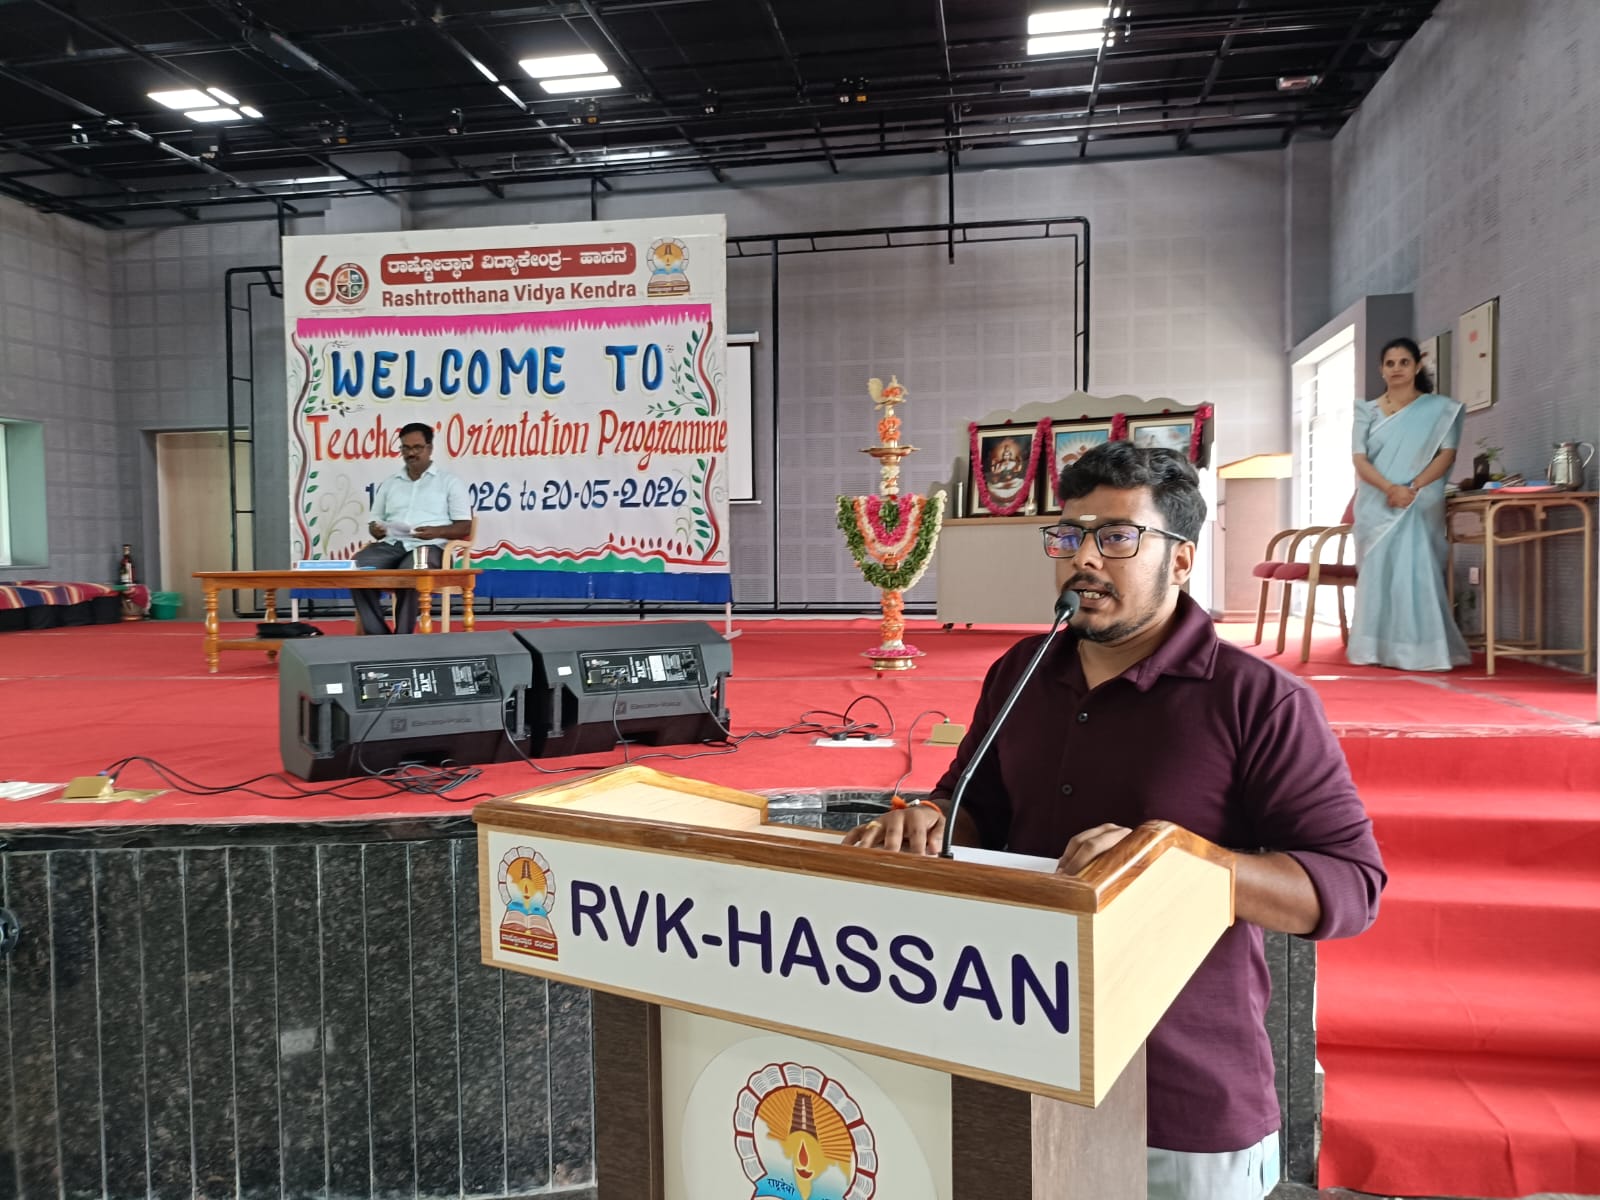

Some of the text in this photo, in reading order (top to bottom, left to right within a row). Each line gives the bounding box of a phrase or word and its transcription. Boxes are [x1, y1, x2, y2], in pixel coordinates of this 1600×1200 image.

[579, 246, 628, 266] ಹಾಸನ
[382, 279, 637, 307] Rashtrotthana Vidya Kendra
[331, 343, 665, 399] WELCOME TO
[446, 409, 590, 459] Orientation
[598, 408, 728, 471] Programme
[520, 480, 537, 511] to
[541, 476, 688, 511] 20-05-2026
[571, 879, 1070, 1034] RVK-HASSAN
